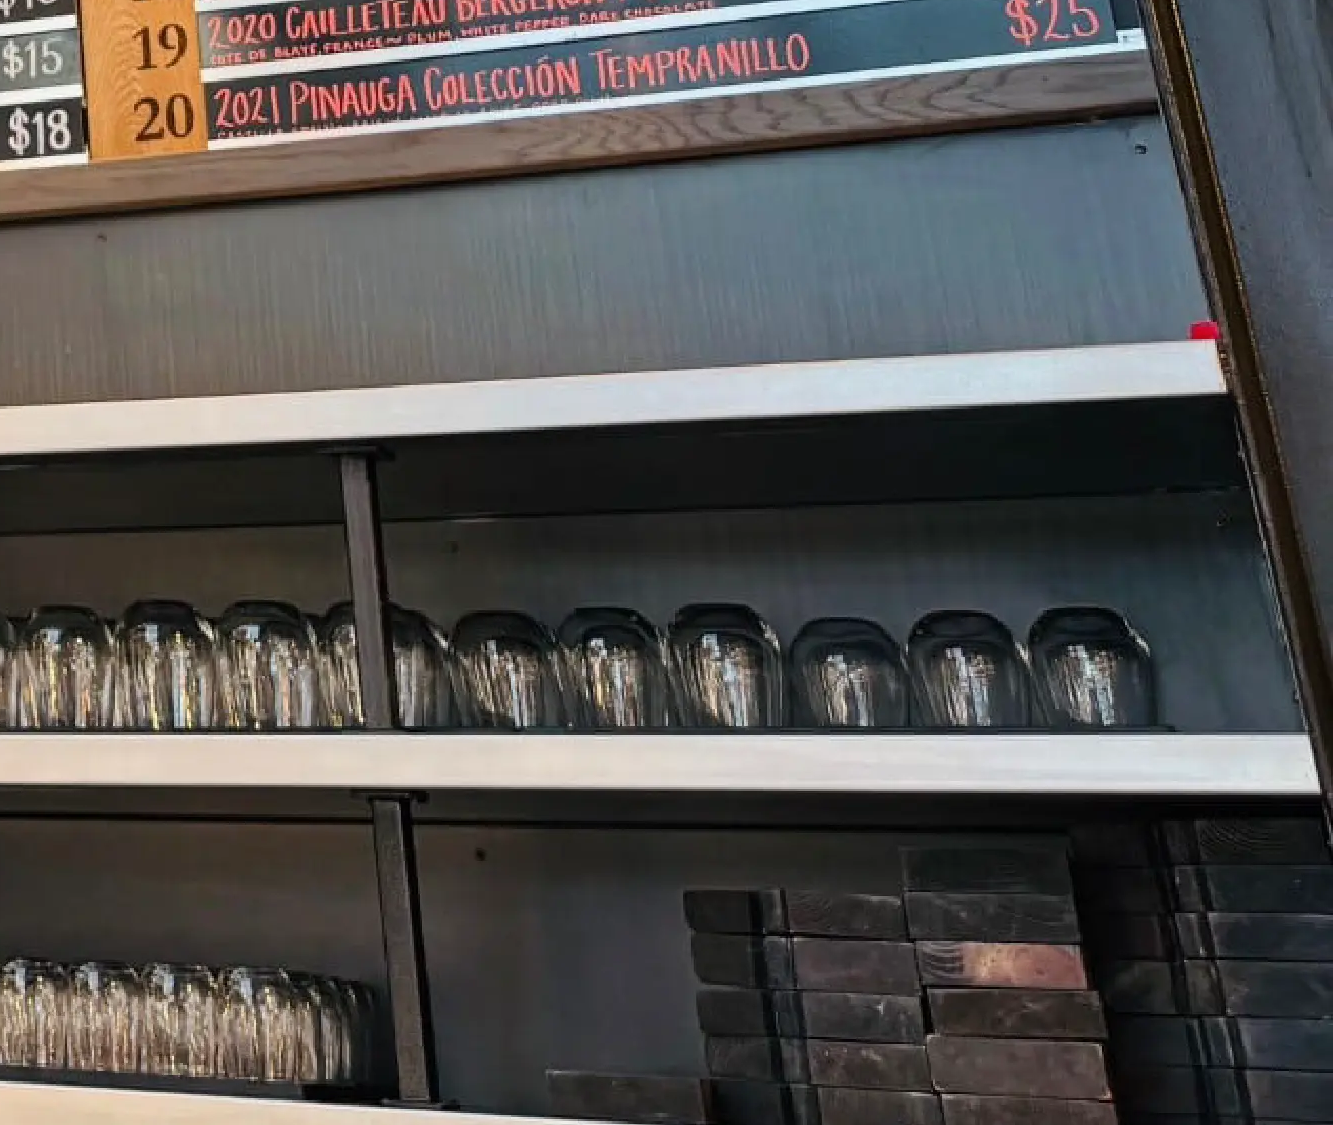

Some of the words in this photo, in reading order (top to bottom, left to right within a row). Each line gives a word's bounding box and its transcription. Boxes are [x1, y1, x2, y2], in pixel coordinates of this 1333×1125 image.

[131, 24, 187, 70] 19
[207, 12, 277, 50] 2020
[2, 37, 63, 79] $15
[213, 86, 280, 127] 2021
[289, 75, 417, 124] PINAUGA
[589, 33, 810, 90] TEMPRANILLO
[8, 107, 72, 155] $18
[134, 93, 193, 141] 20
